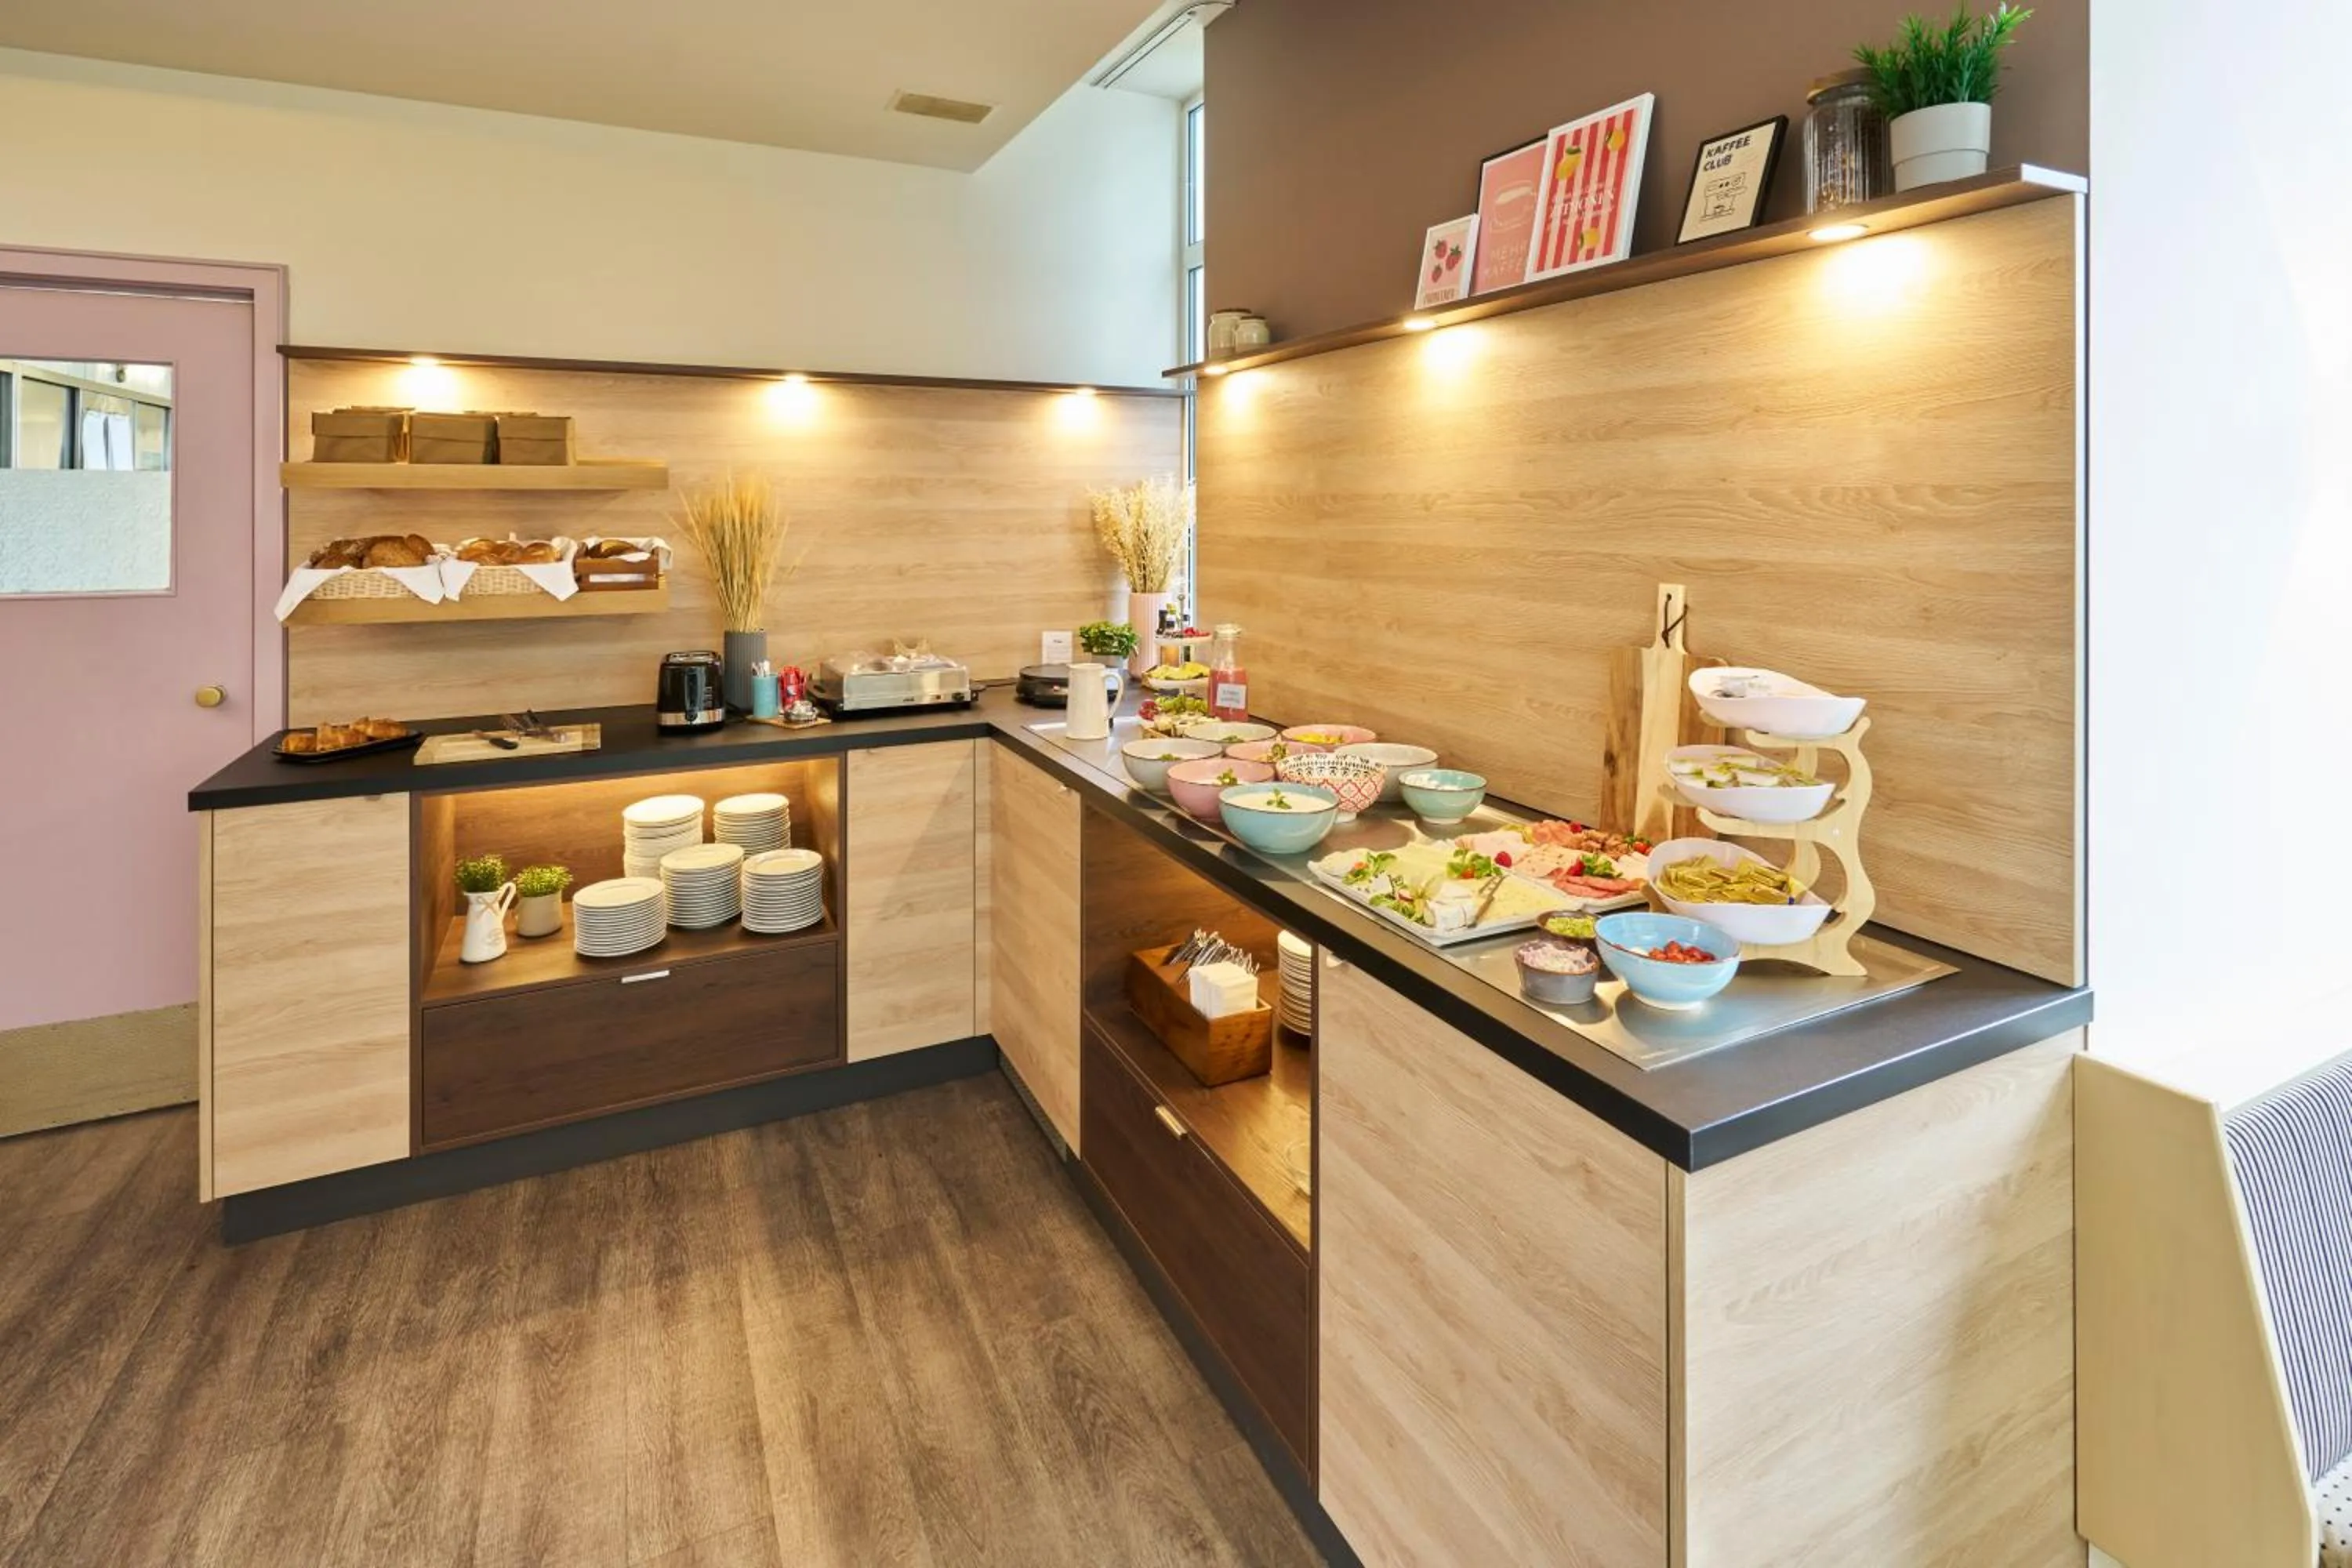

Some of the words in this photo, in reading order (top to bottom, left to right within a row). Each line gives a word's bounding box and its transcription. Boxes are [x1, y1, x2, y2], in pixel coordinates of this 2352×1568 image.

[1706, 135, 1751, 158] KAFFEE
[1704, 154, 1733, 171] CLUB
[1483, 258, 1524, 279] KAFFE
